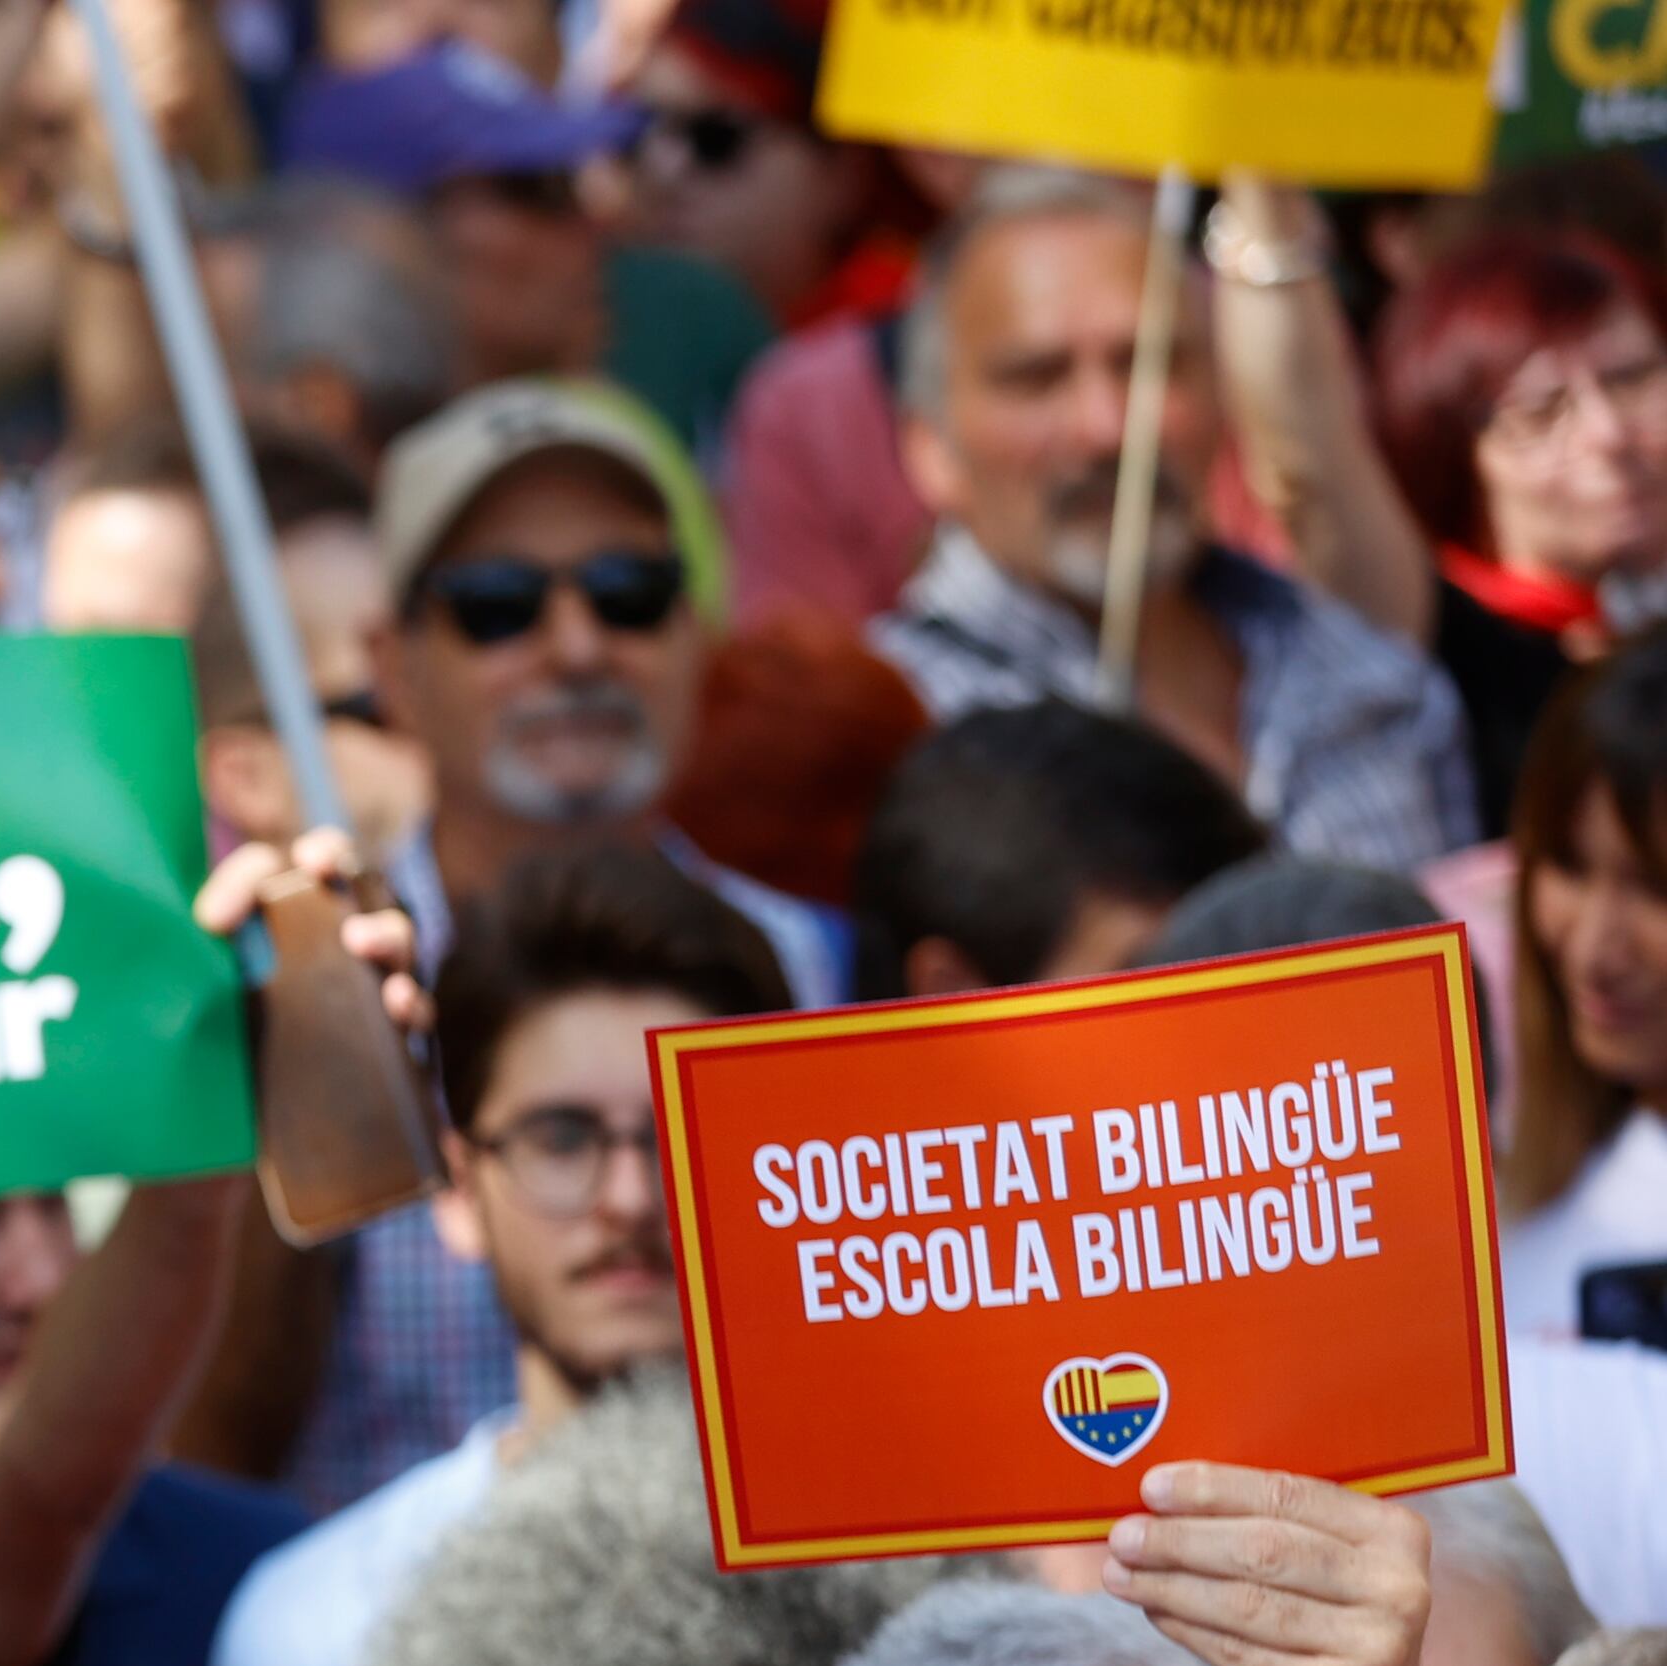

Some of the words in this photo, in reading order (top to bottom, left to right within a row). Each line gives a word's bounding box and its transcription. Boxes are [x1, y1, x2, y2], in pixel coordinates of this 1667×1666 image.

[753, 1115, 1074, 1228] SOCIETAT
[1093, 1060, 1401, 1194] BILINGÜE
[796, 1219, 1059, 1323] ESCOLA
[1072, 1164, 1379, 1298] BILINGÜE
